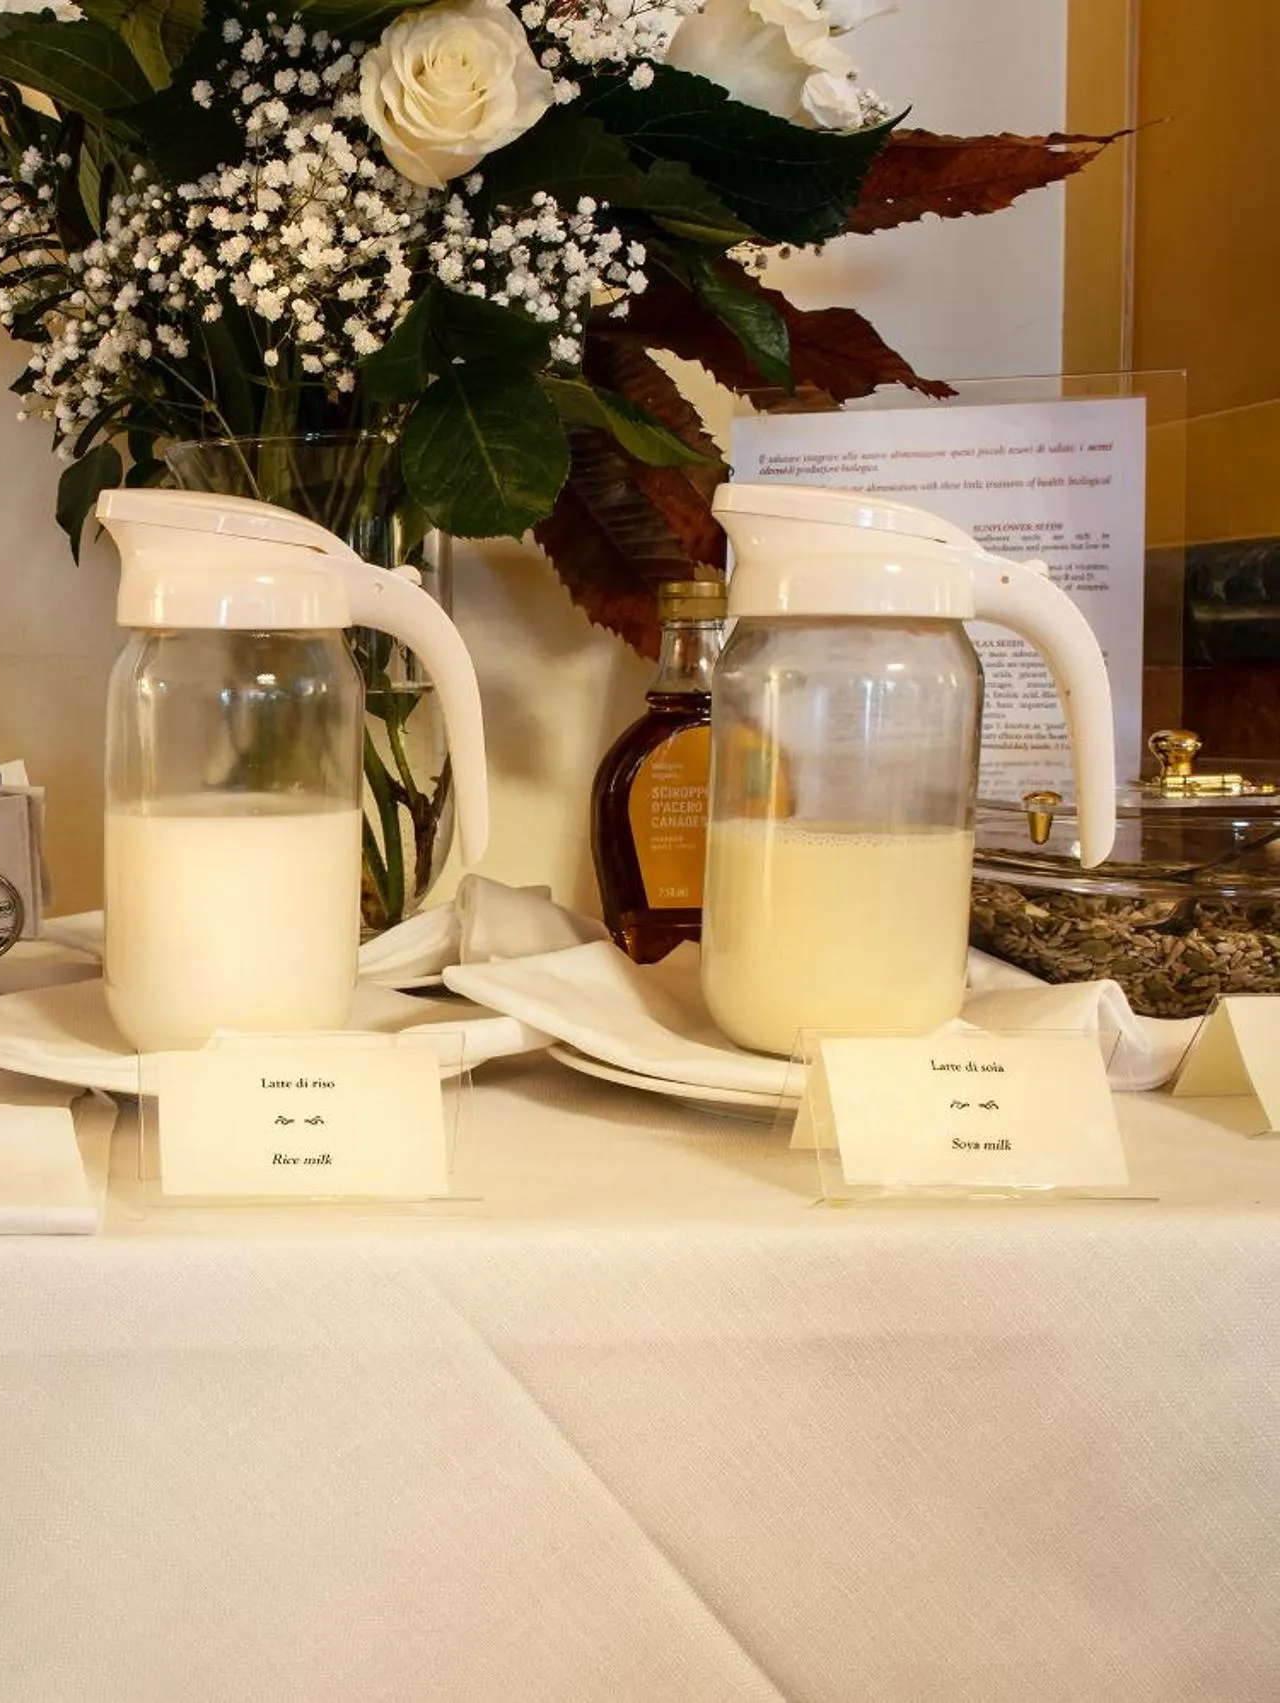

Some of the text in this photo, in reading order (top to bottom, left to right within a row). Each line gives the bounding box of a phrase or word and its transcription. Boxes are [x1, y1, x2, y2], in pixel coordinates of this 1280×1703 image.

[974, 639, 995, 648] LAX
[931, 1060, 1005, 1073] Latte di soia
[260, 1077, 336, 1089] Latte di riso
[952, 1138, 1012, 1152] Soya milk
[272, 1153, 333, 1166] Rice milk
